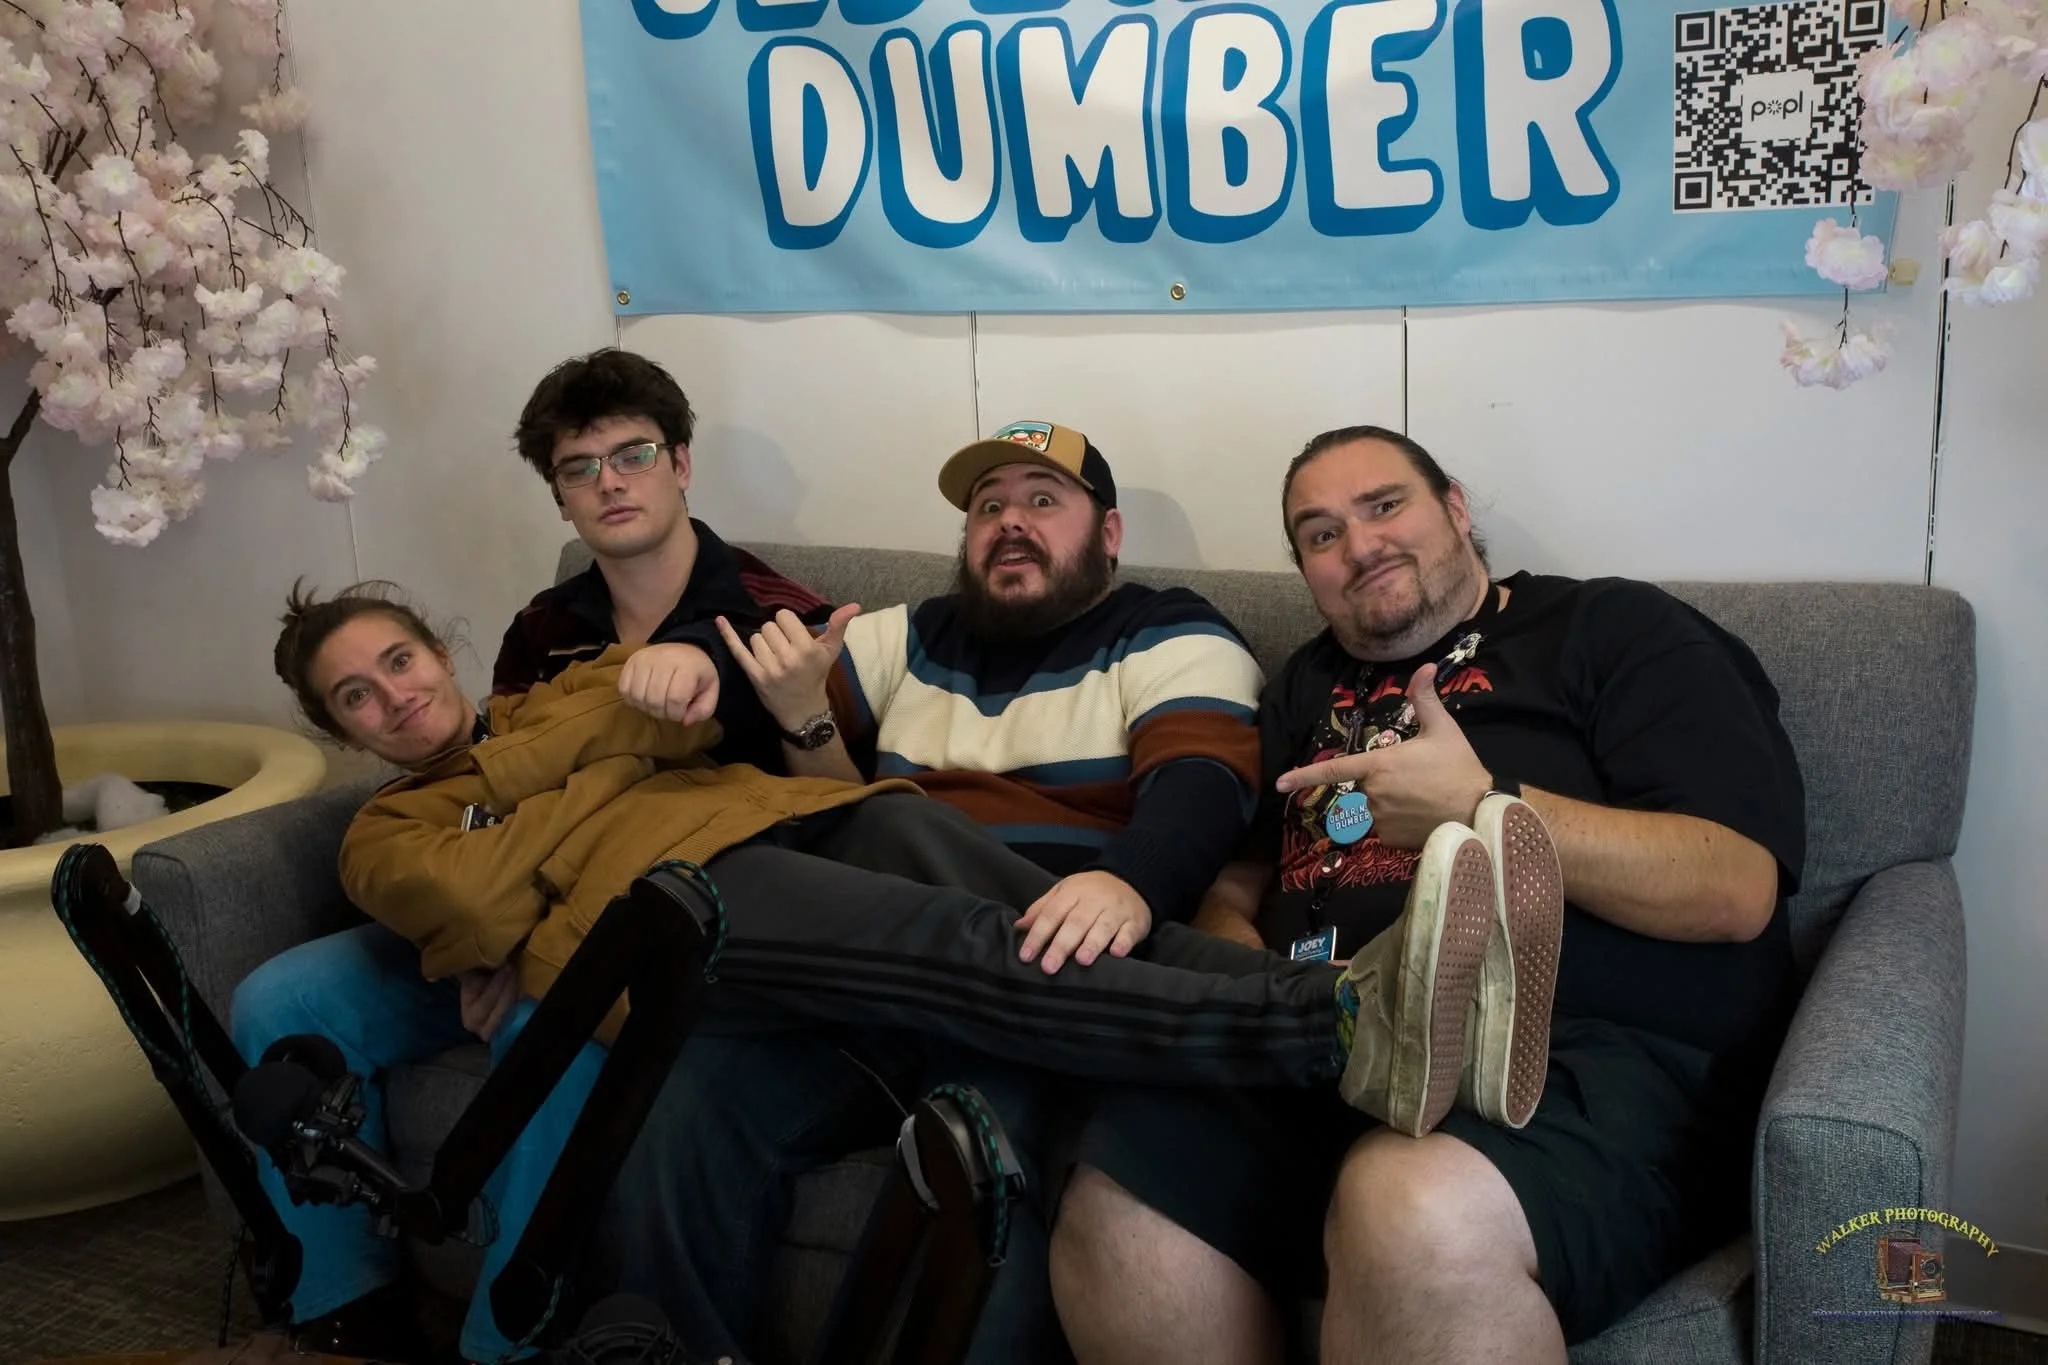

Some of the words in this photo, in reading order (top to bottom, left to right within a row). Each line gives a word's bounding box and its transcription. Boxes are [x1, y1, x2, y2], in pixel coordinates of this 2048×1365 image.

[749, 0, 1621, 248] DUMBER
[1335, 811, 1371, 831] DUMBER
[1298, 937, 1326, 953] JOEY
